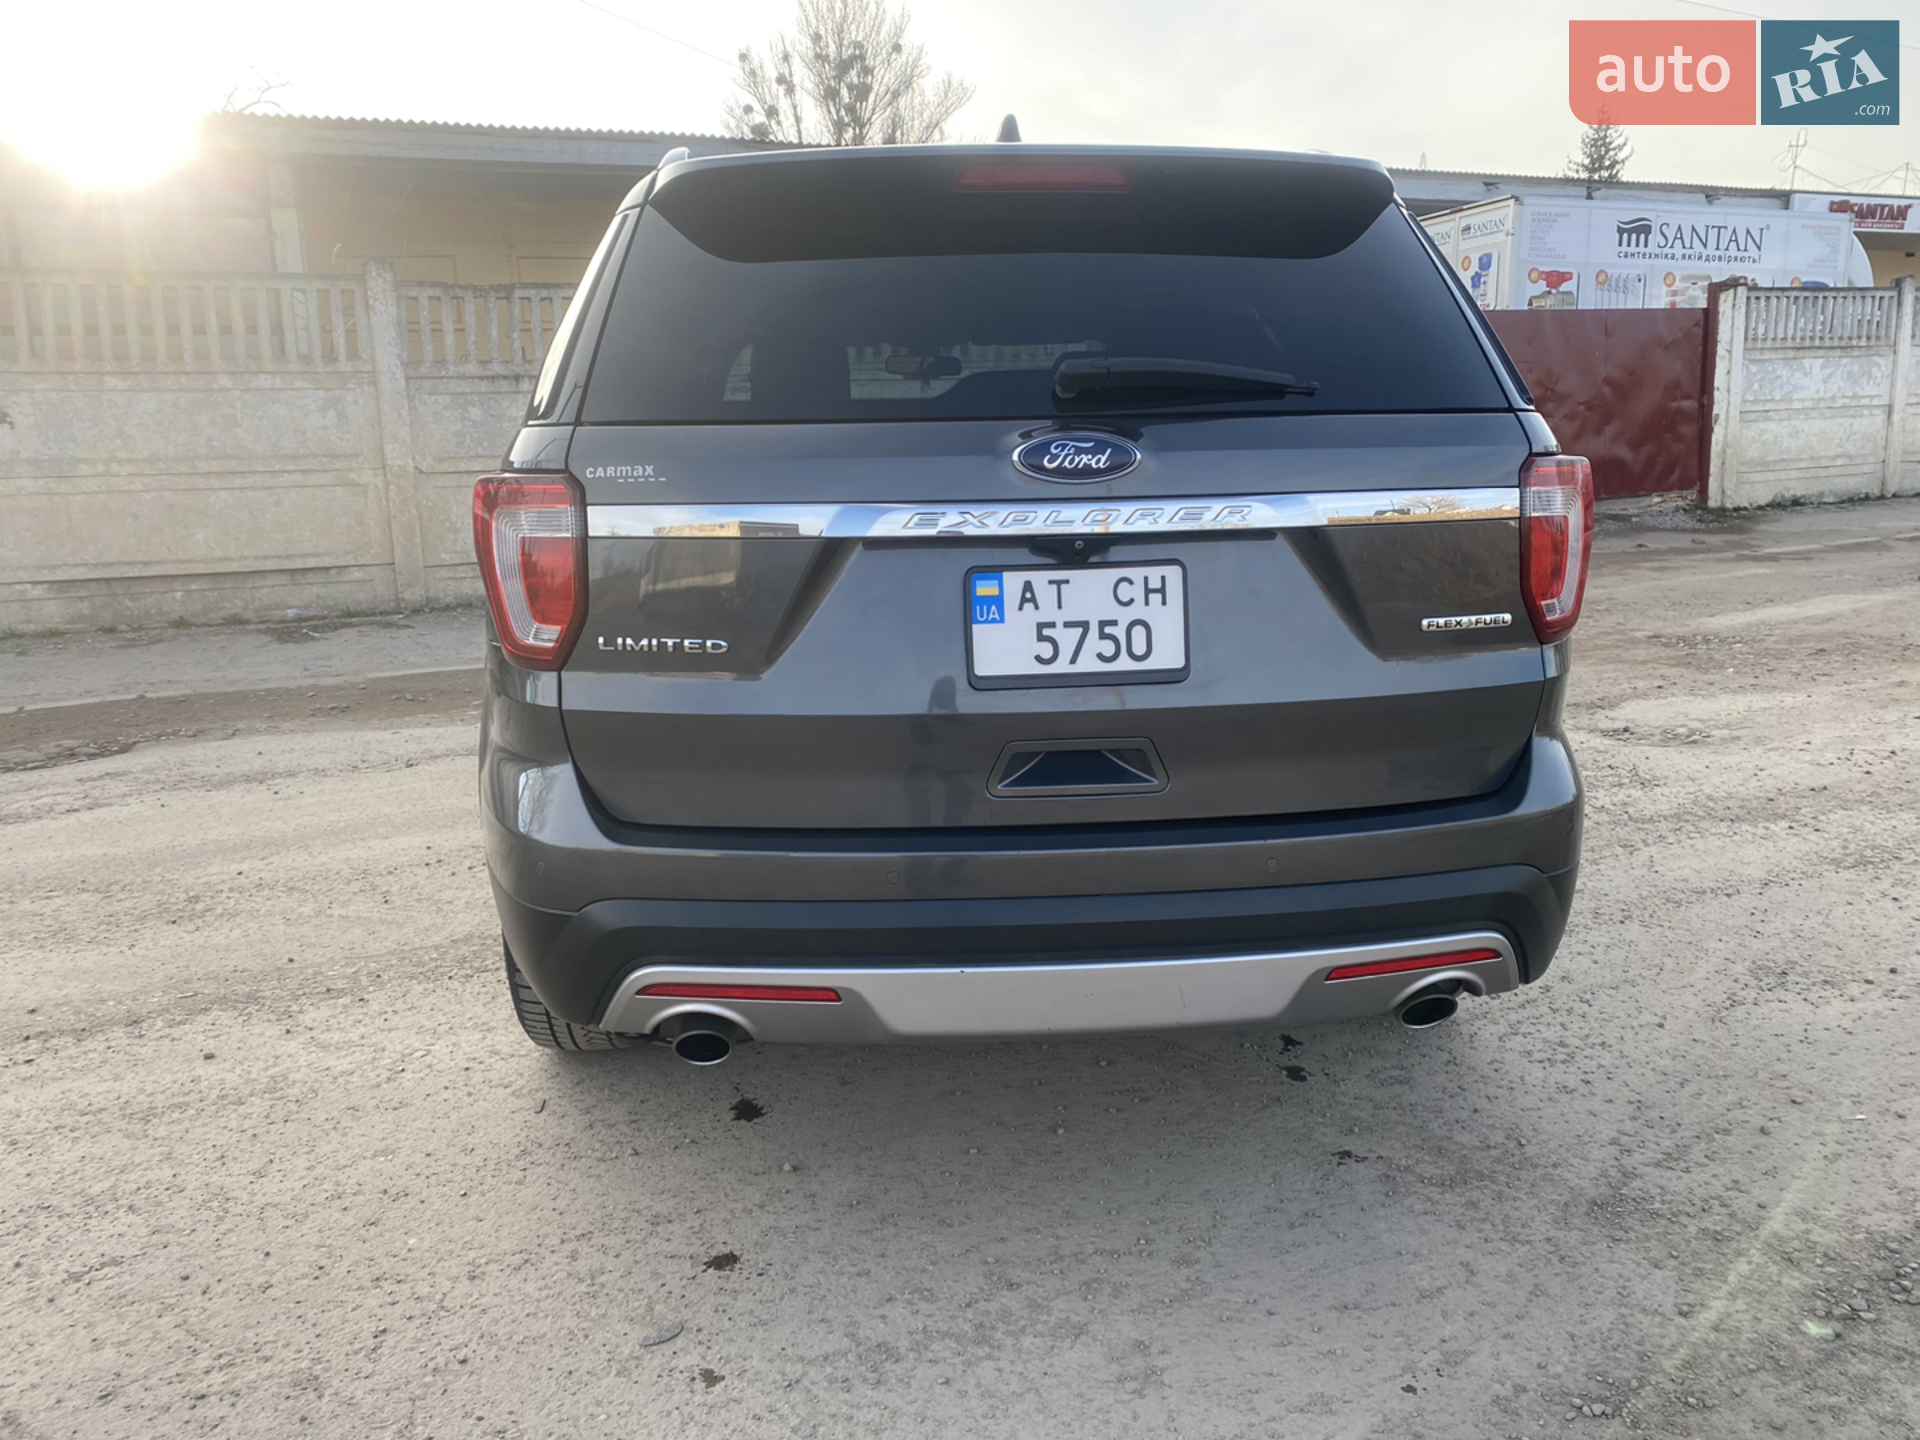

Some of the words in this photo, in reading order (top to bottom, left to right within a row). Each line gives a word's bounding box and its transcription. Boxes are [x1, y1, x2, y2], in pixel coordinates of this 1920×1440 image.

[1657, 222, 1765, 252] SANTAN
[1617, 250, 1680, 262] сантехніка,
[1043, 440, 1112, 470] Ford
[586, 464, 654, 478] CARmax
[901, 504, 1253, 530] EXPLORER
[1018, 579, 1070, 611] AT
[1112, 574, 1167, 607] CH
[976, 604, 1000, 622] UA
[1427, 618, 1463, 629] FLEX
[1474, 615, 1509, 627] FUEL
[598, 636, 729, 654] LIMITED
[1034, 618, 1153, 666] 5750
